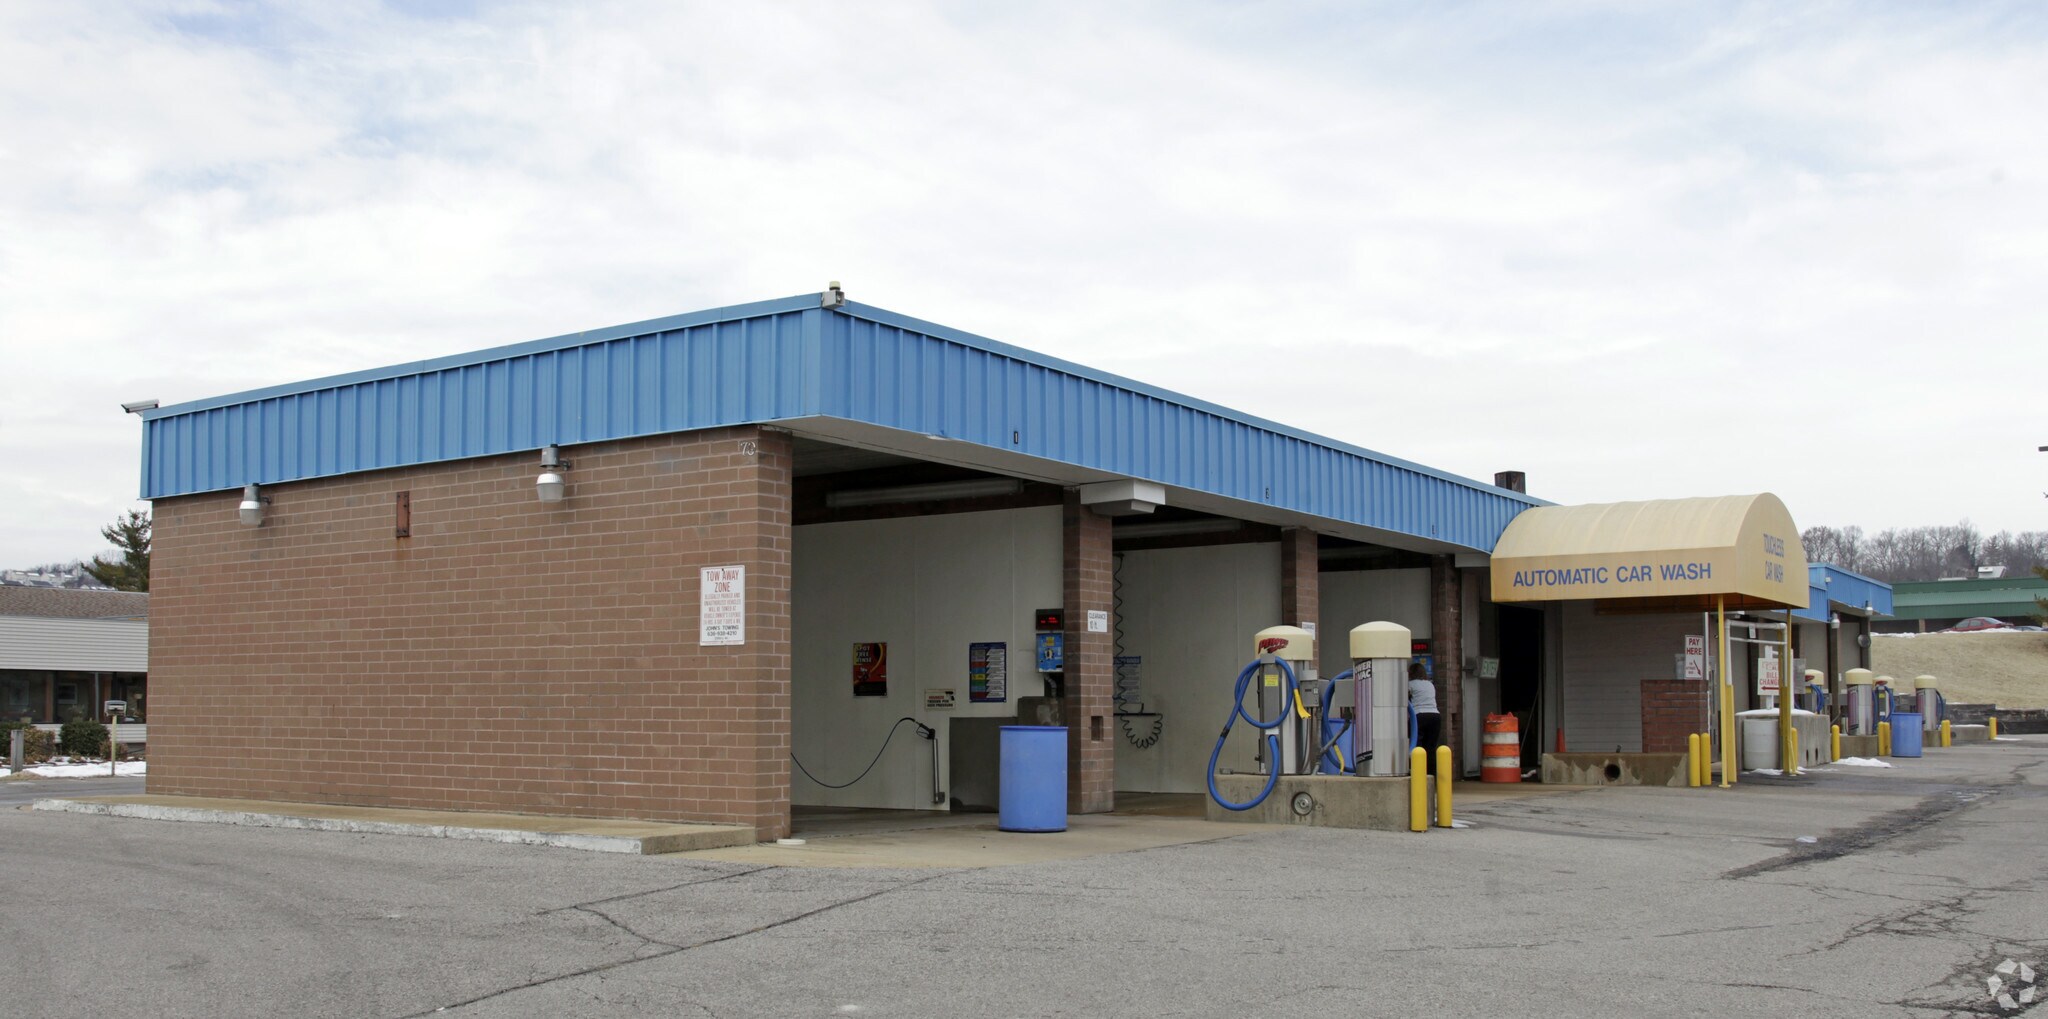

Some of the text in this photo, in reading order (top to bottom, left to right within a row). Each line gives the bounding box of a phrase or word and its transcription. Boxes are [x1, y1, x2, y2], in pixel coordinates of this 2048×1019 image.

[1763, 533, 1784, 558] TOUCHLESS
[706, 569, 740, 581] TOW AWAY
[1513, 562, 1711, 587] AUTOMATIC CAR WASH
[1765, 560, 1784, 583] CAR WASH
[714, 582, 730, 593] ZONE
[1689, 638, 1700, 646] PAY
[1686, 647, 1702, 655] HERE
[1358, 669, 1371, 680] VAC
